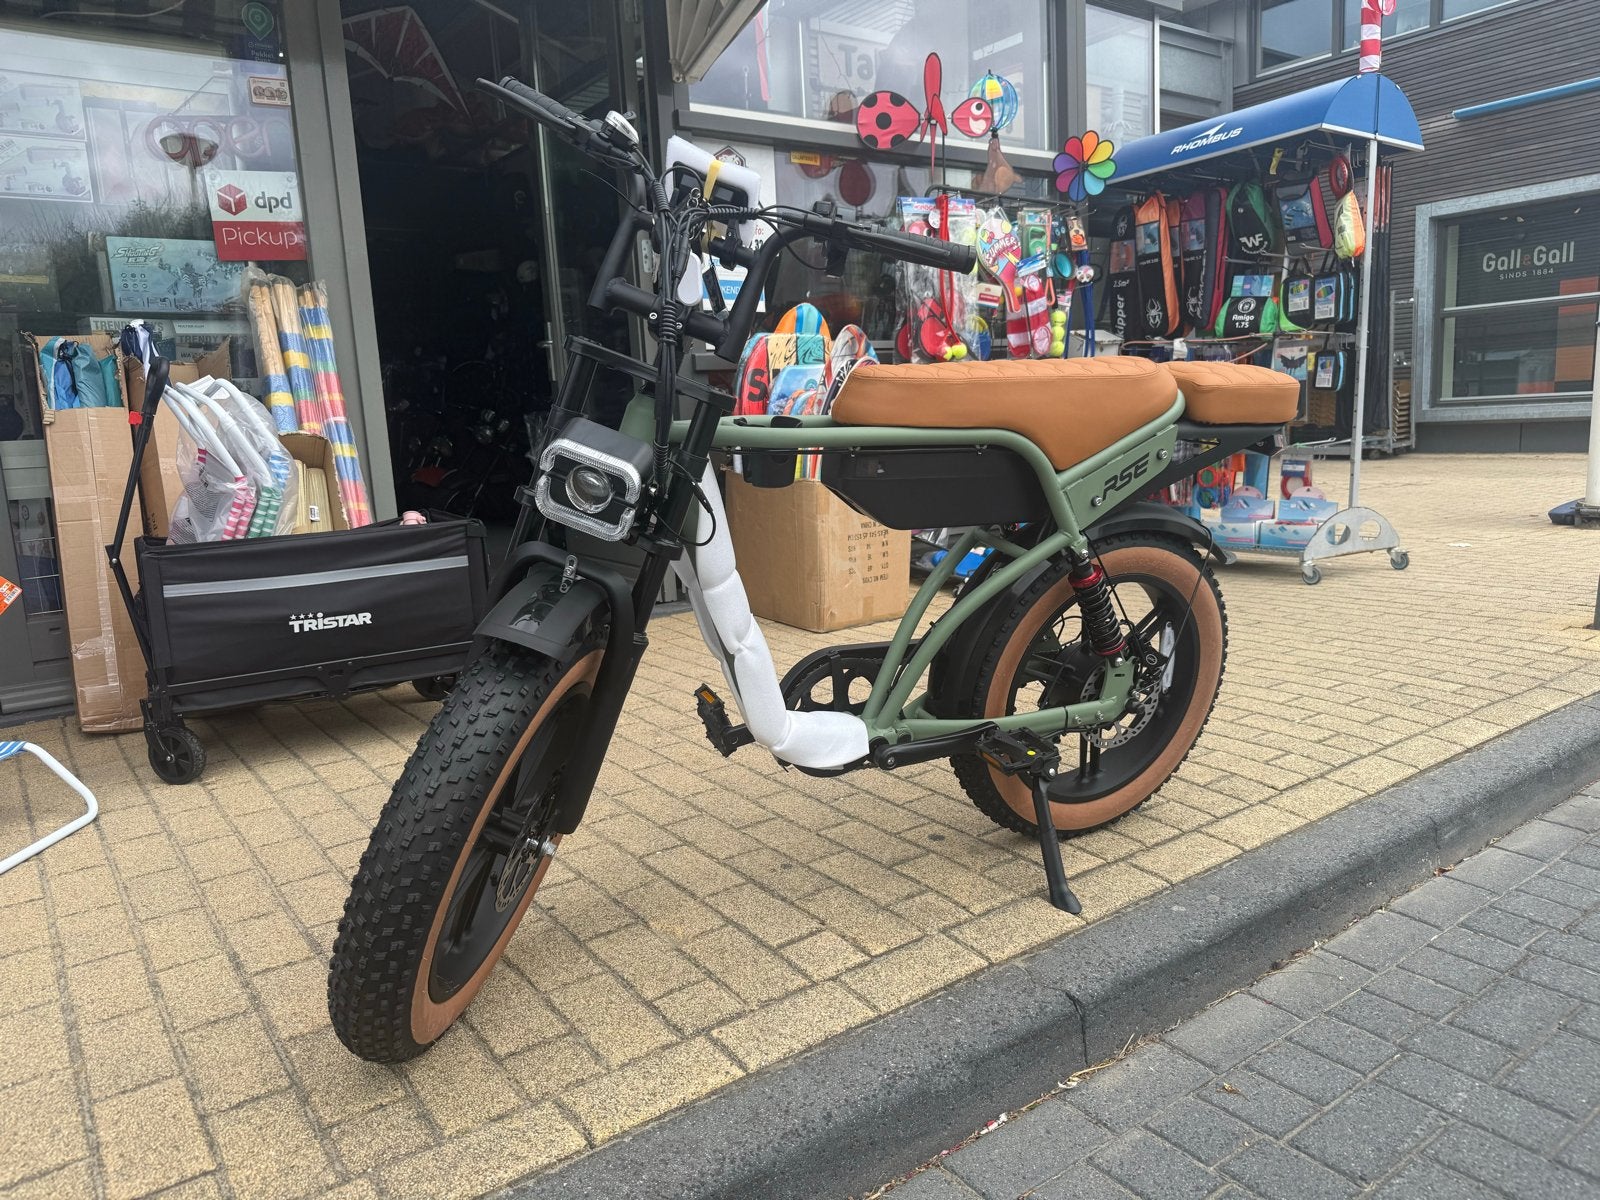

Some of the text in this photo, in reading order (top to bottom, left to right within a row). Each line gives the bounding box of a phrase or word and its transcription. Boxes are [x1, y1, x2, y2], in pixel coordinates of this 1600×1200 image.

[1171, 127, 1243, 155] RHOMBUS
[254, 191, 293, 213] dpd
[222, 227, 298, 249] Pickup
[1482, 248, 1521, 272] Gall
[1533, 241, 1575, 266] Gall
[1499, 267, 1553, 280] SINDS 1884
[1232, 314, 1254, 322] Amigo
[1103, 452, 1150, 501] RSE
